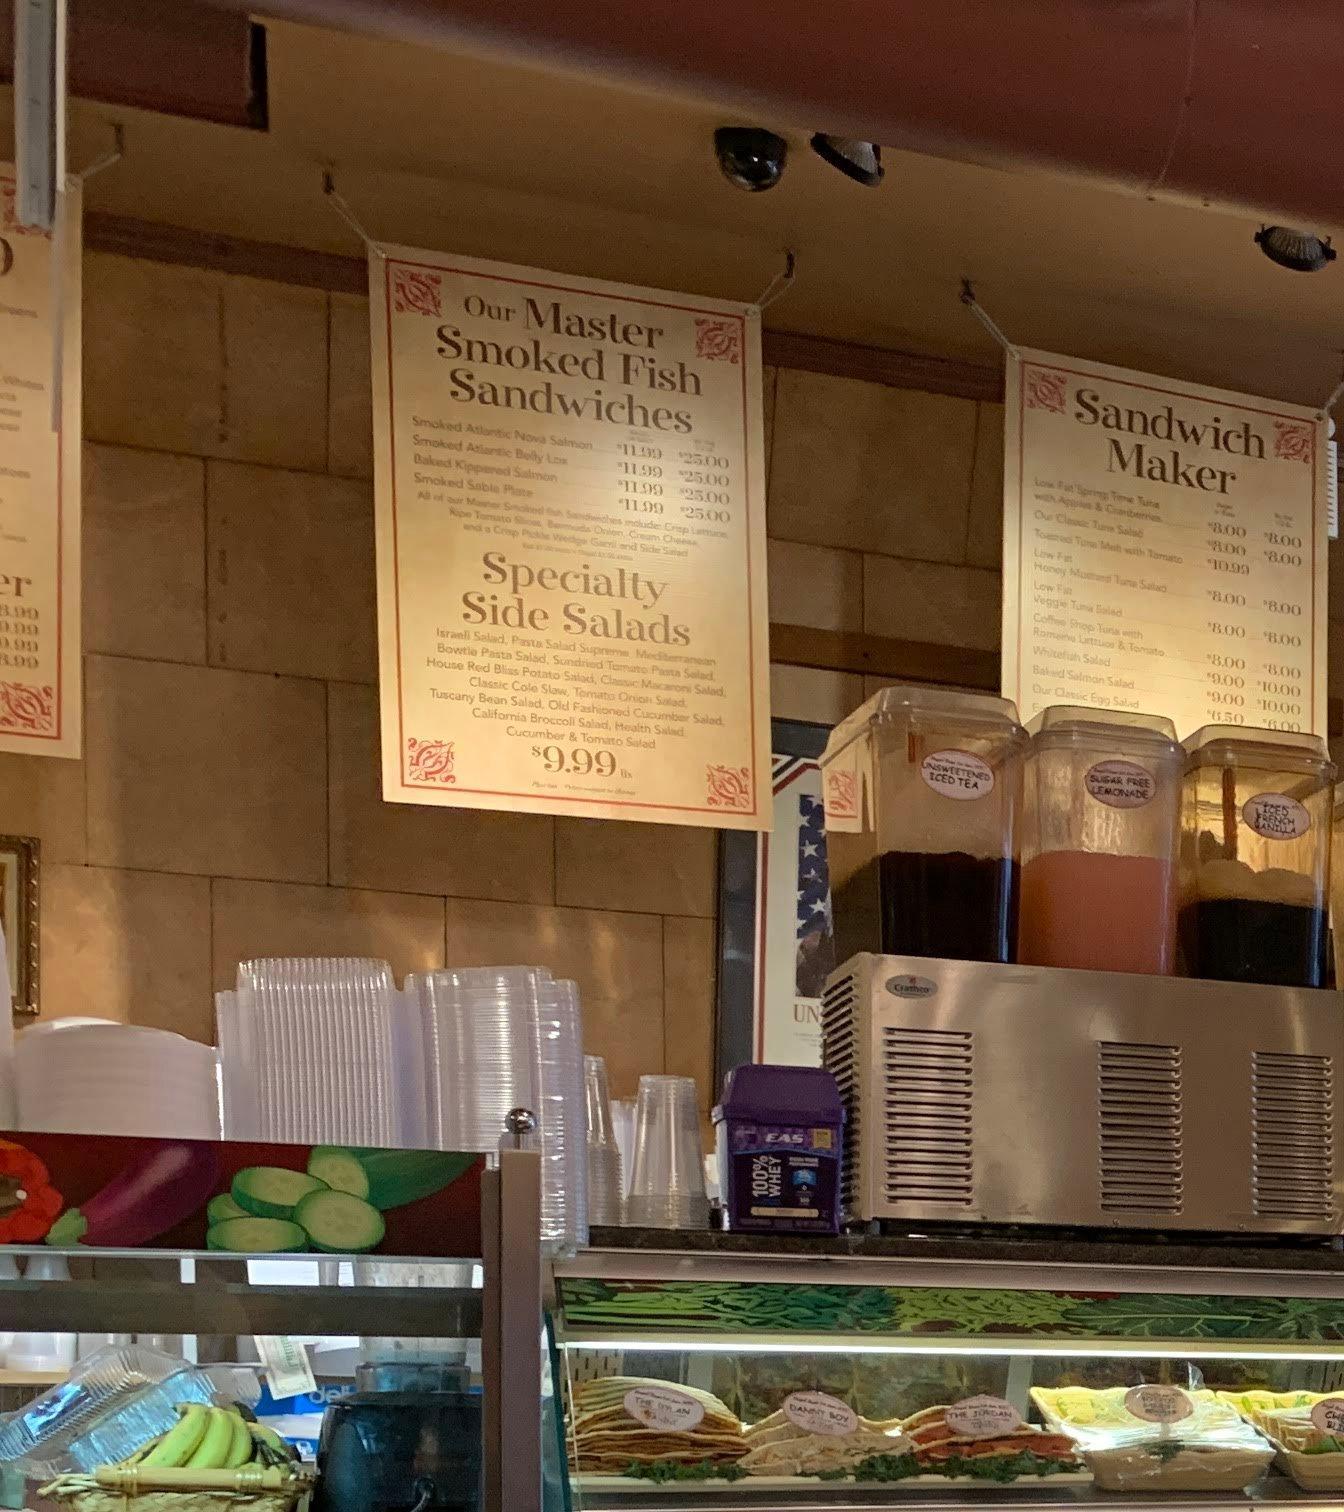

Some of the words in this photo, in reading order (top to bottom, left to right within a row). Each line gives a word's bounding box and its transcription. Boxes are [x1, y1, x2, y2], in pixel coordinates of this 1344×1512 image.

[463, 295, 516, 323] Our
[522, 297, 663, 349] Master
[436, 324, 605, 381] Smoked
[618, 352, 704, 397] Fish
[449, 368, 693, 435] Sandwiches
[1073, 387, 1268, 461] Sandwich
[1105, 437, 1237, 495] Maker
[1264, 532, 1302, 548] $8.00
[1264, 551, 1302, 567] $8.00
[482, 551, 670, 610] Specialty
[462, 591, 550, 631] Side
[562, 602, 691, 647] Salads
[427, 657, 464, 671] House
[468, 661, 490, 673] Red
[522, 667, 560, 680] Potato
[469, 676, 508, 690] Classic
[512, 680, 538, 692] Cole
[430, 688, 475, 705] Tuscany
[478, 692, 507, 705] Bean
[548, 700, 569, 711] Old
[472, 707, 527, 722] California
[530, 713, 575, 727] Broccoli
[506, 726, 566, 740] Cucumber
[568, 732, 577, 741] &
[580, 732, 623, 746] Tomato
[626, 737, 656, 749] Salad
[531, 744, 617, 777] $9.99
[922, 761, 991, 784] UNSWEETENED
[928, 773, 950, 787] ICED
[957, 778, 980, 791] TEA
[1089, 774, 1123, 788] SUGAR
[1125, 776, 1152, 789] FREE
[1091, 785, 1151, 799] LEMONADE
[1255, 813, 1296, 827] FRENCH
[1262, 803, 1290, 816] ICED
[1253, 823, 1298, 836] VANILLA
[765, 1132, 804, 1144] EAS
[752, 1155, 768, 1198] 100%
[769, 1155, 782, 1198] WHEY
[789, 1403, 826, 1418] DANNY
[828, 1411, 849, 1424] BOY
[950, 1410, 970, 1420] THE
